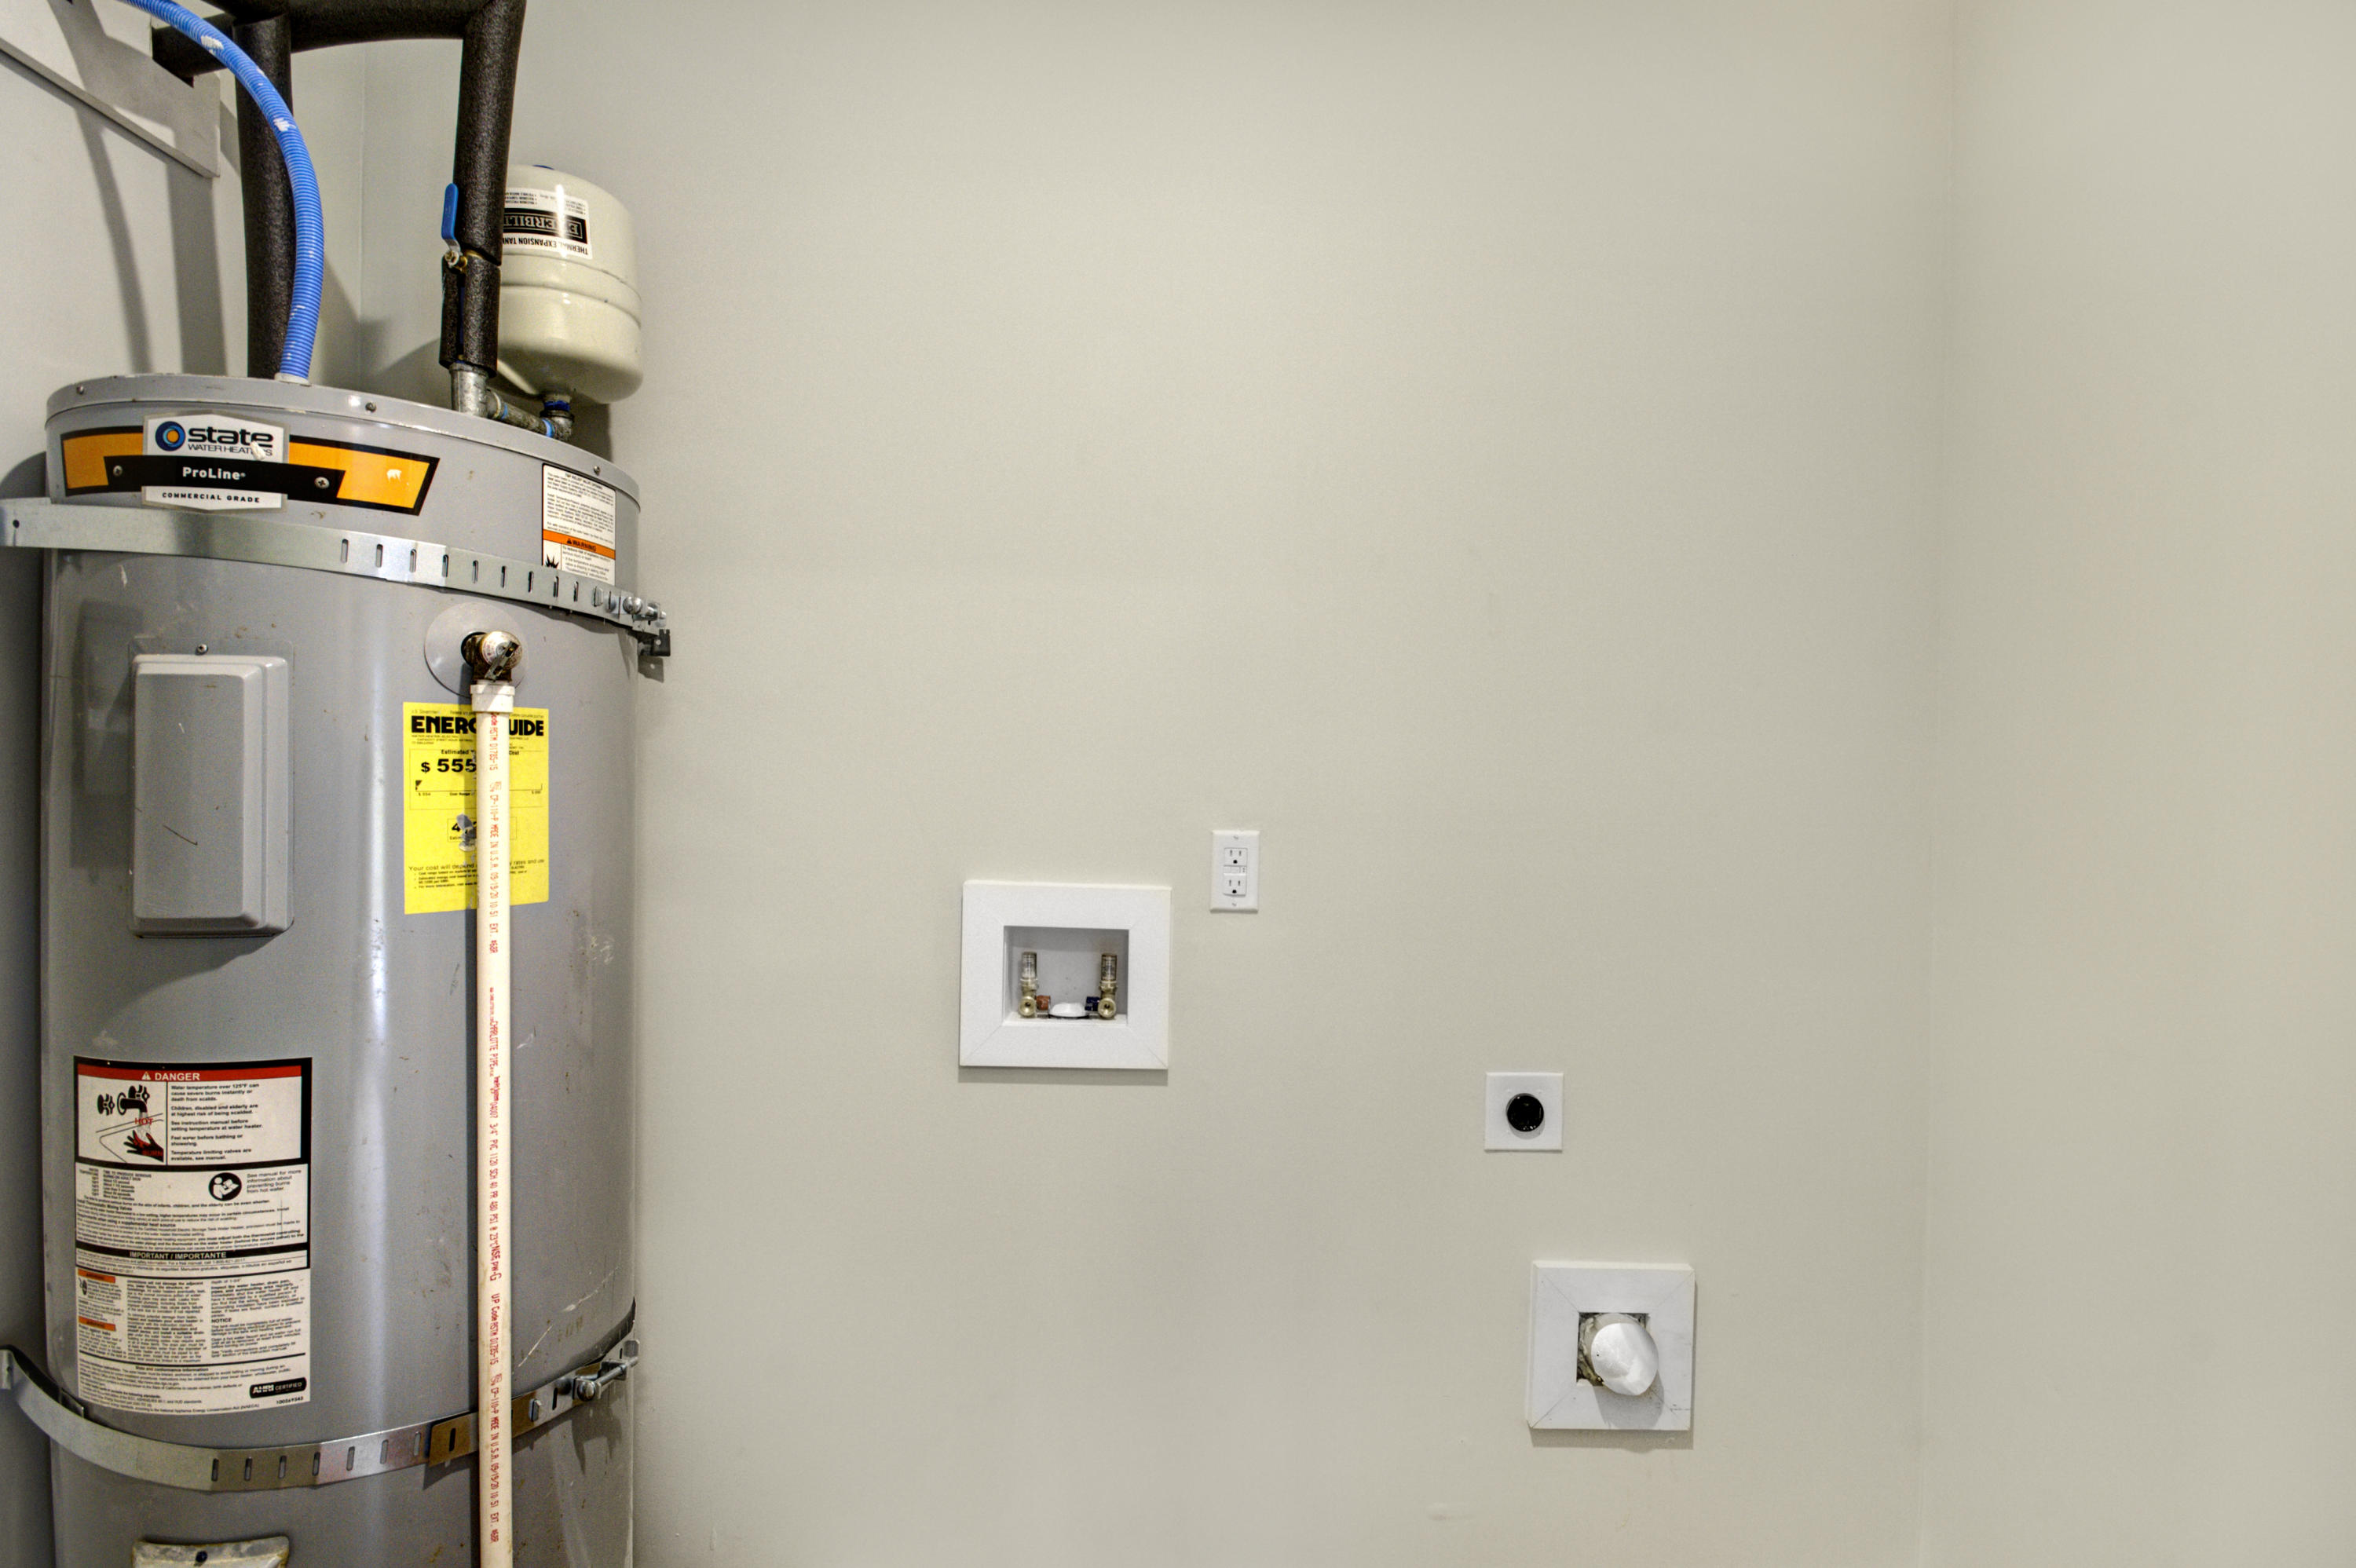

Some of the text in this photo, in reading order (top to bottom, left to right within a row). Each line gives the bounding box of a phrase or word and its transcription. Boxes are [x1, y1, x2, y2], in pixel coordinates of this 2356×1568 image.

[503, 214, 578, 235] EERBILT
[518, 238, 557, 248] EXPANSION
[558, 241, 588, 255] THERML
[188, 426, 273, 448] state
[188, 444, 273, 456] WATER HEATS
[573, 539, 596, 552] WARNING
[490, 727, 499, 741] ASTM
[421, 758, 477, 774] $ 555
[490, 795, 499, 821] CP-110-P
[490, 824, 499, 838] MADE
[490, 850, 499, 870] U.S.A.
[490, 923, 499, 938] EXT.
[489, 1021, 499, 1051] CHARLOTTE
[490, 1053, 499, 1067] PIPE
[490, 1139, 499, 1150] PVC
[490, 1153, 499, 1167] 1120
[490, 1168, 499, 1180] SCH
[490, 1190, 499, 1199] PR
[490, 1213, 499, 1224] PSI
[175, 1252, 227, 1260] IMPORTANTE
[492, 1293, 500, 1303] UP
[492, 1306, 500, 1321] Code
[490, 1321, 499, 1337] ASTM
[275, 1382, 302, 1391] CERTIFIED
[491, 1387, 499, 1414] CP-110-P
[491, 1416, 499, 1431] MADE
[491, 1432, 499, 1441] IN
[491, 1442, 499, 1462] U.S.A.
[491, 1511, 499, 1527] EXT.
